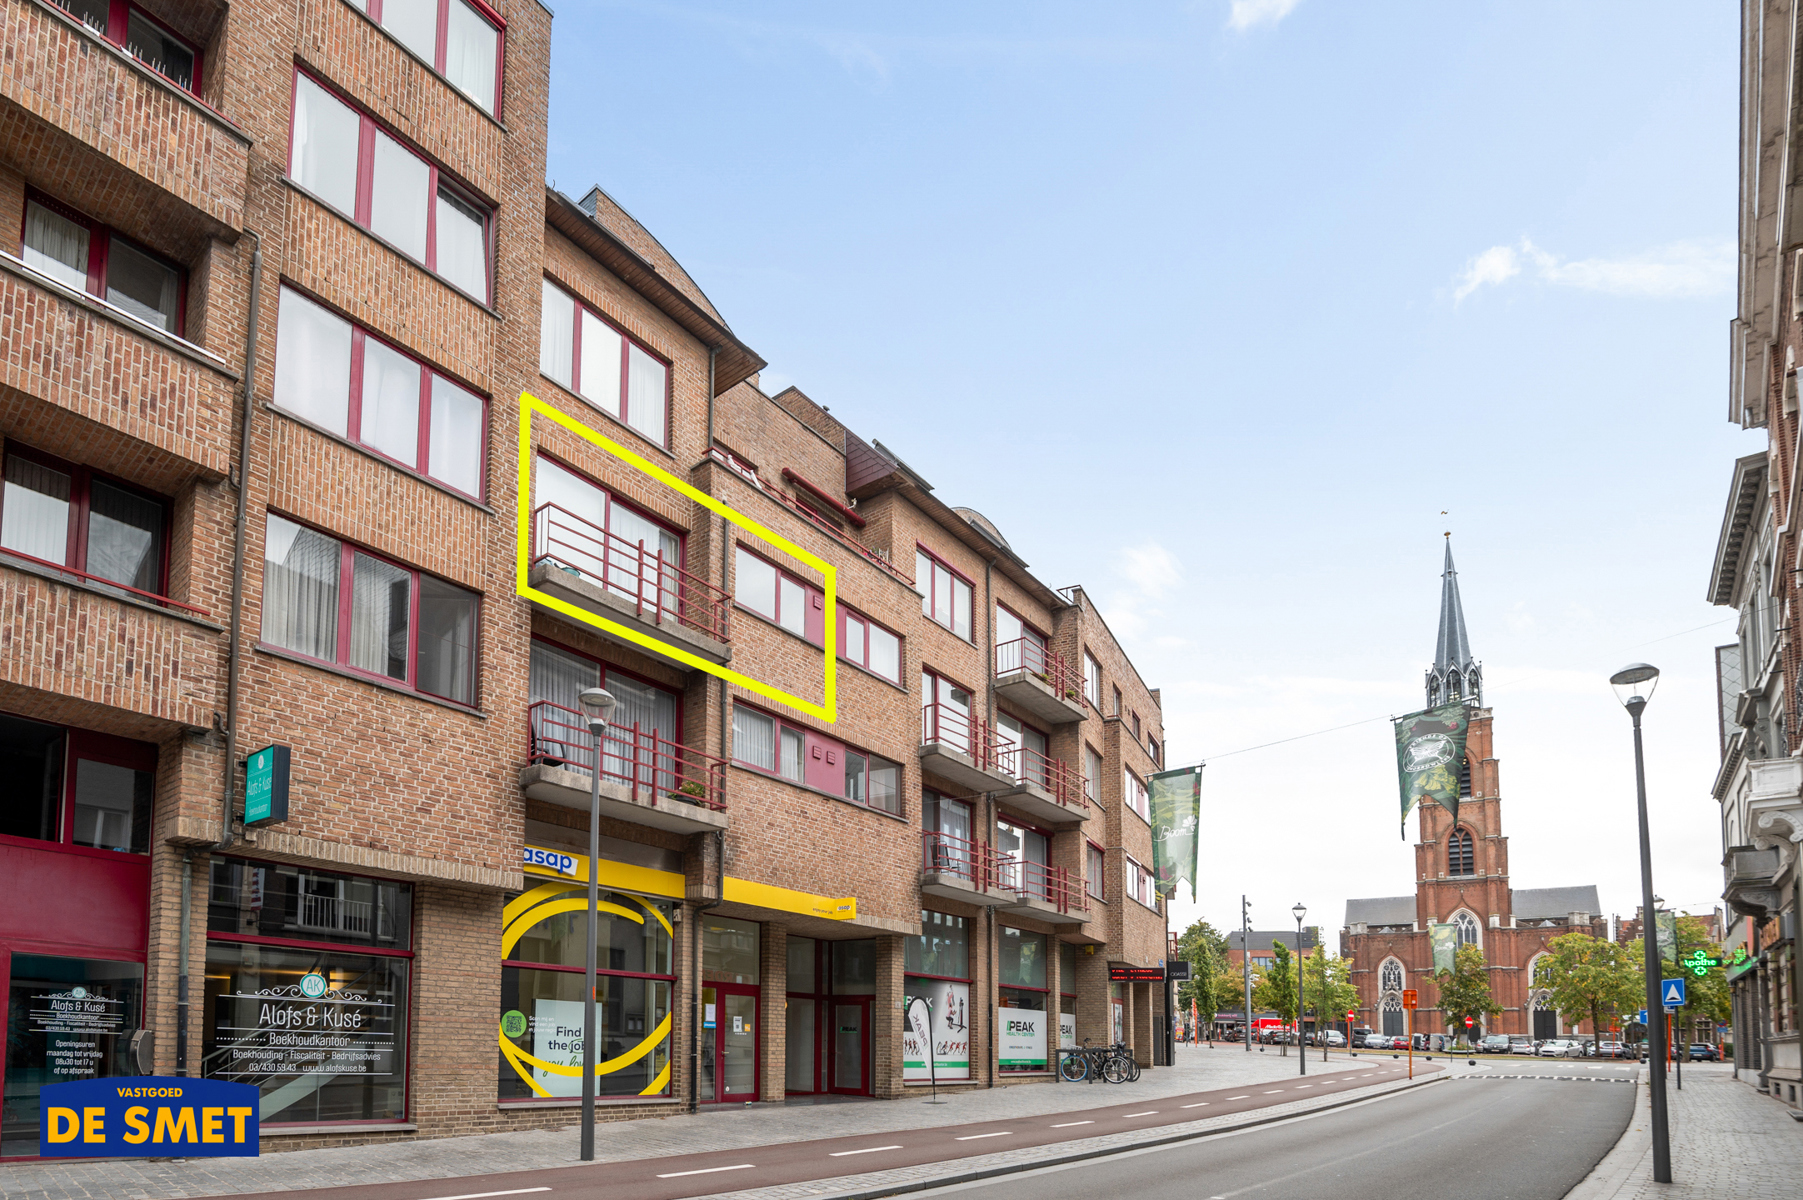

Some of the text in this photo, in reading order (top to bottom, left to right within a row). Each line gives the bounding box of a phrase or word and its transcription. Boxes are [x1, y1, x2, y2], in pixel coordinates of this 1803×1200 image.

[1154, 825, 1194, 841] Boom
[524, 847, 572, 873] asap
[306, 978, 320, 992] AK
[51, 1000, 105, 1012] Alofs & Kusé
[259, 1003, 362, 1029] Alofs & Kusé
[556, 1026, 581, 1037] Find
[1009, 1020, 1034, 1032] PEAK
[56, 1040, 95, 1048] Openingsuren
[270, 1032, 350, 1046] Boekhoudkantoor
[548, 1040, 568, 1050] the
[232, 1049, 284, 1060] Boekhouding
[290, 1051, 325, 1060] Fiscaliteit
[331, 1052, 381, 1062] Bedrijfsadvies
[249, 1062, 366, 1073] 03/430.59.43 www.alofskuse.be
